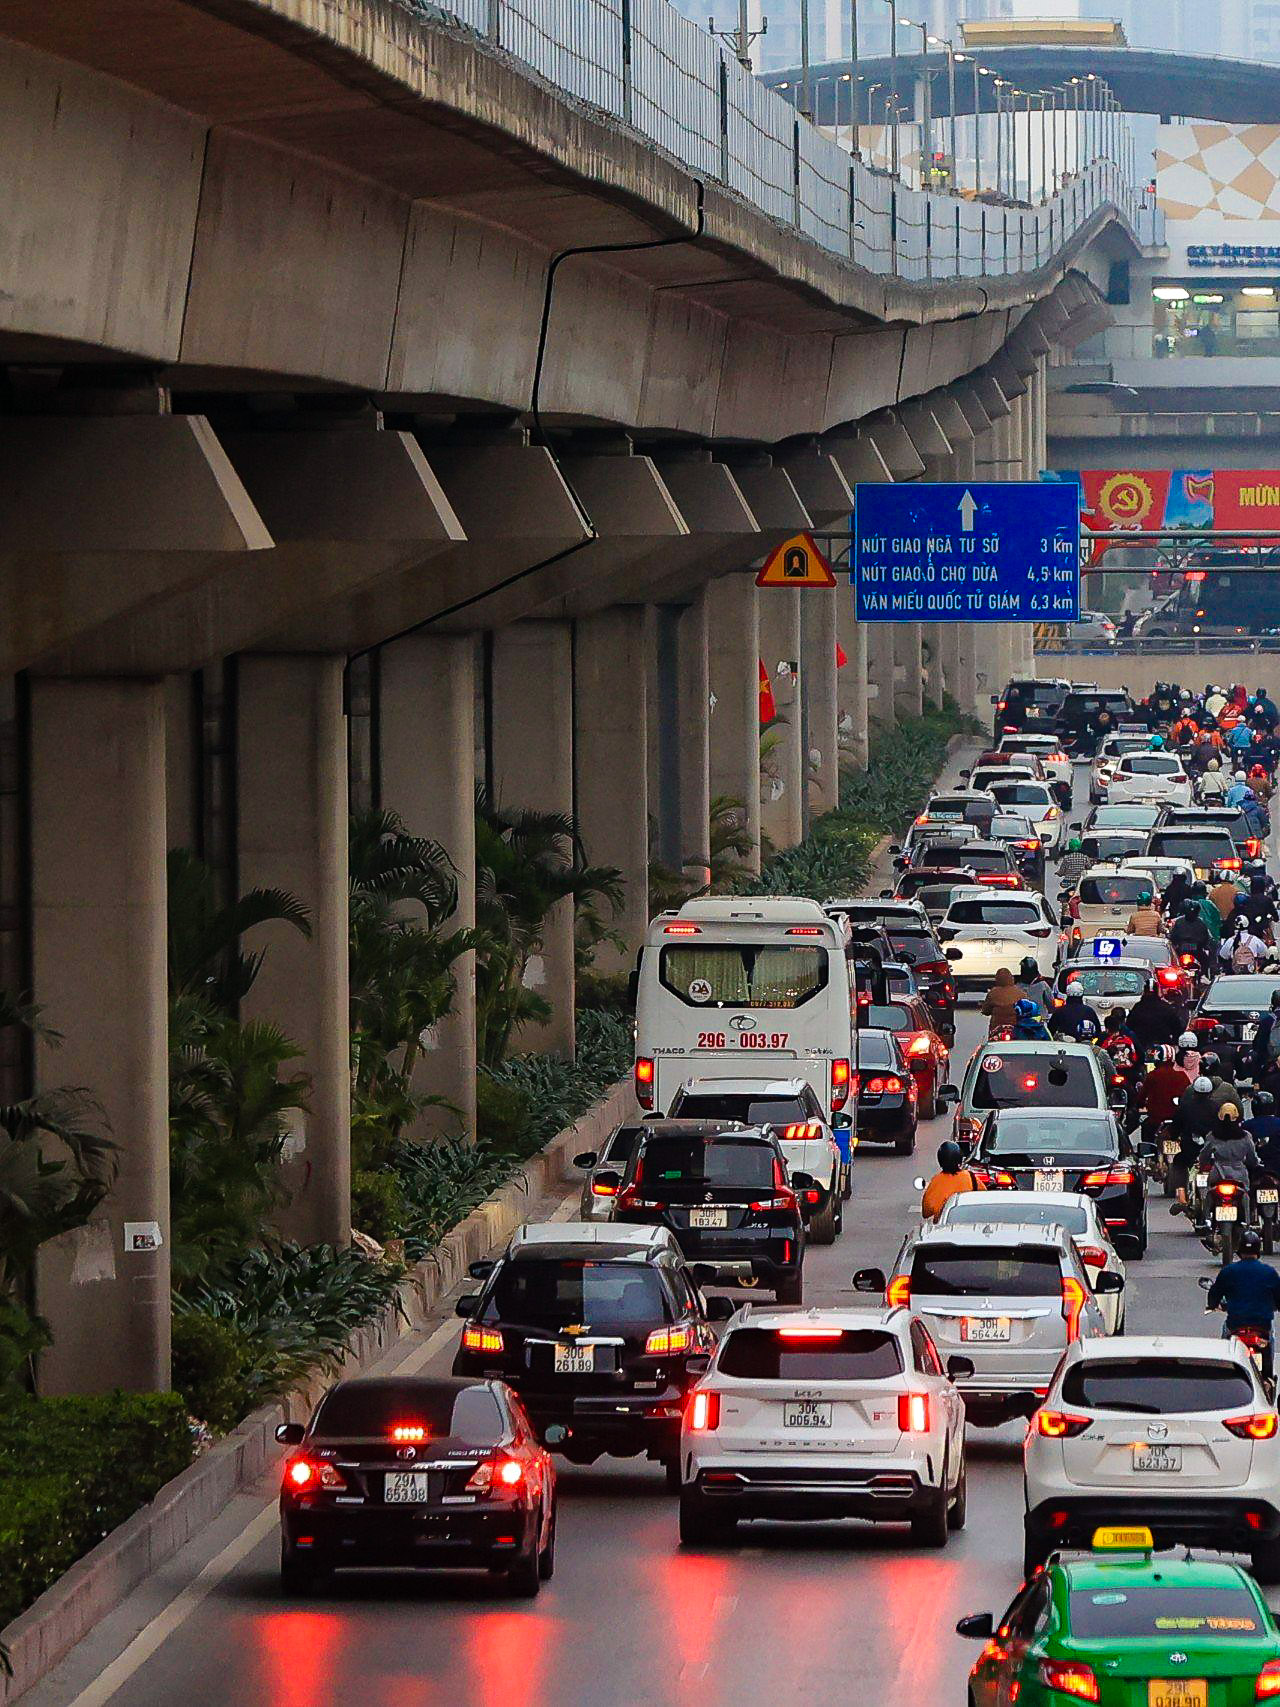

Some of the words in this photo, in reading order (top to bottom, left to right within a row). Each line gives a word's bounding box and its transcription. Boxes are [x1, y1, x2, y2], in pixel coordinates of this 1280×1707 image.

[861, 533, 888, 553] NÚT
[892, 538, 921, 553] GIAO
[1040, 538, 1048, 553] 3
[1053, 538, 1073, 553] km
[861, 562, 888, 582] NÚT
[892, 567, 921, 582] GIAO
[941, 566, 966, 585] CHỢ
[1027, 566, 1050, 584] 4,5
[1054, 567, 1073, 582] km
[892, 588, 923, 610] MIẾU
[927, 588, 962, 610] QUỐC
[988, 590, 1020, 610] GIÁM
[1031, 595, 1050, 611] 6,3
[1053, 595, 1073, 610] km
[697, 1033, 726, 1048] 29G
[740, 1033, 789, 1048] 003.97
